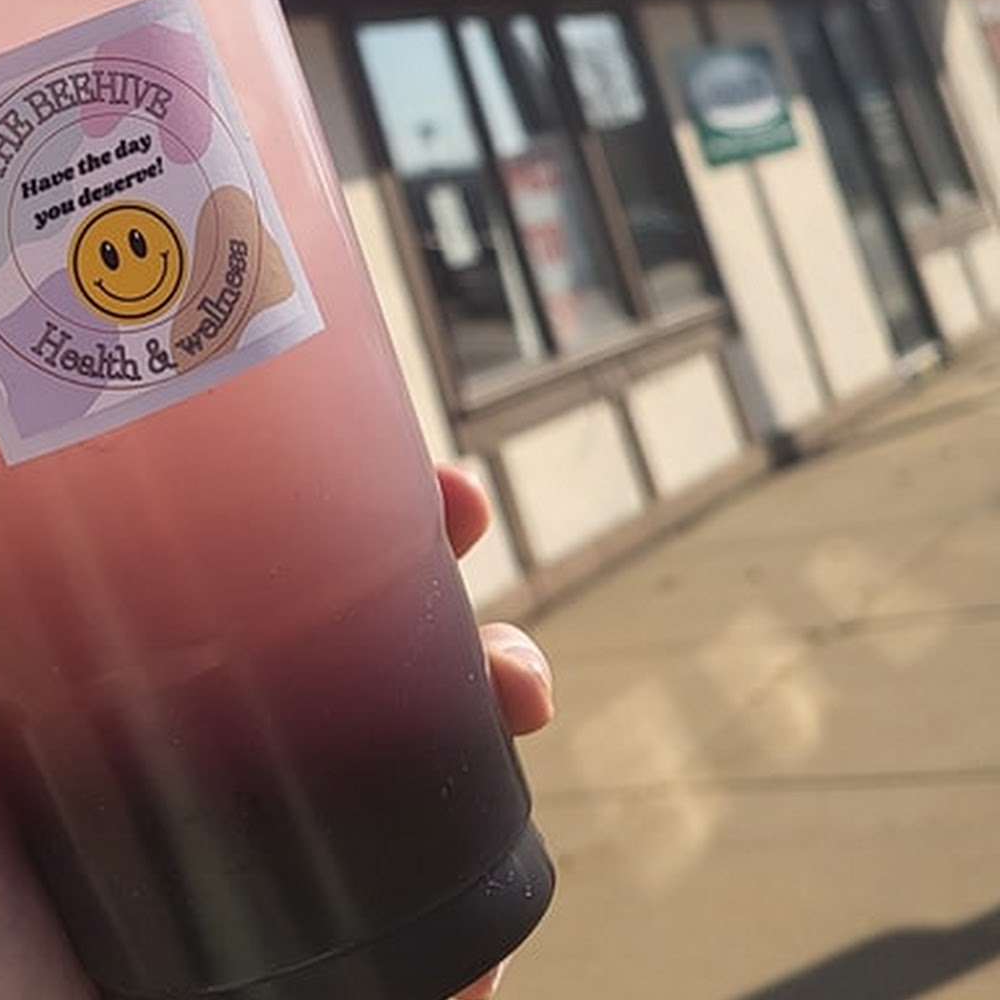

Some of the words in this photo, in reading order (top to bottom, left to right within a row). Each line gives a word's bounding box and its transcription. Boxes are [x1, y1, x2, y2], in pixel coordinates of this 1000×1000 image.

[23, 70, 173, 125] BEEHIVE
[21, 166, 76, 200] Have
[77, 152, 113, 177] the
[115, 133, 152, 156] day
[33, 199, 76, 231] you
[77, 156, 164, 208] deserve!
[30, 321, 142, 382] Health
[146, 338, 178, 375] &
[174, 239, 249, 356] wellness
